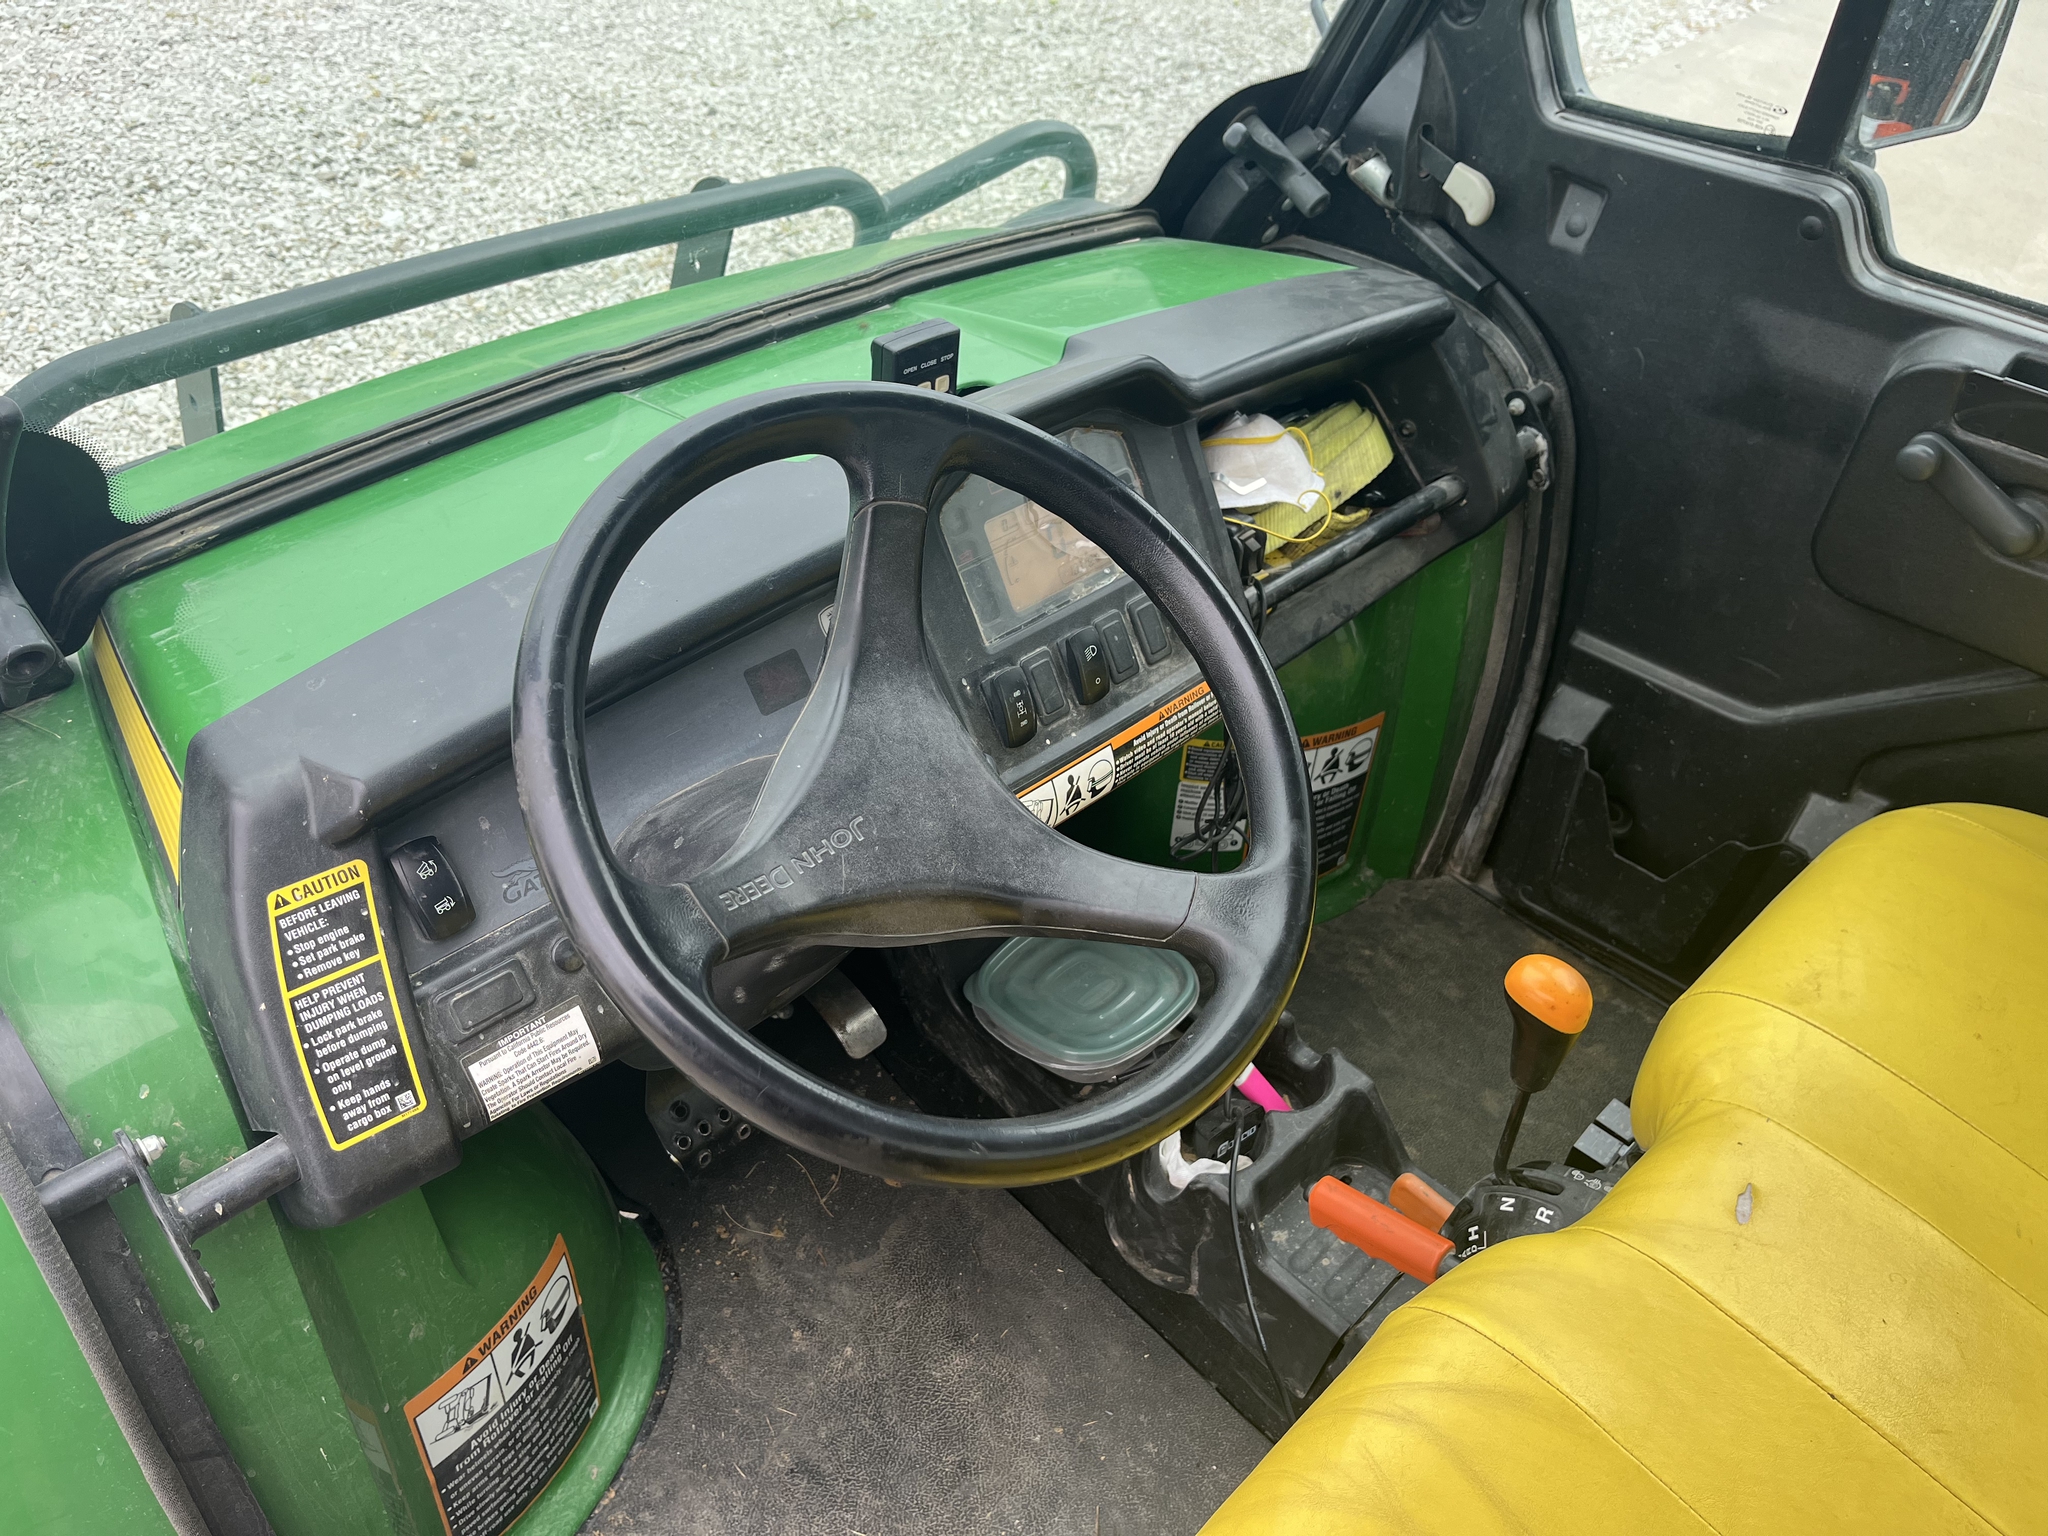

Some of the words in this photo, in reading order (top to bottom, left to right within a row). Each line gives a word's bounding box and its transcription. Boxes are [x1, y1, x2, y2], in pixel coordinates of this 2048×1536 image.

[903, 366, 917, 375] OPEN
[920, 358, 937, 369] CLOSE
[940, 353, 954, 363] STOP
[1164, 687, 1205, 716] WARNING
[1313, 727, 1357, 747] WARNING
[791, 816, 865, 875] JOHN
[291, 864, 361, 902] CAUTION
[718, 865, 795, 912] DEERE
[279, 905, 319, 930] BEFORE
[319, 889, 361, 912] LEAVING
[284, 918, 330, 942] VEHICLE:
[292, 940, 316, 955] Stop
[318, 925, 350, 945] engine
[299, 953, 317, 967] Set
[318, 944, 339, 961] park
[340, 932, 366, 950] brake
[303, 957, 343, 978] Remove
[343, 948, 361, 962] key
[294, 992, 320, 1011] HELP
[321, 973, 366, 999] PREVENT
[299, 999, 336, 1022] INJURY
[336, 985, 368, 1006] WHEN
[304, 1007, 351, 1034] DUMPING
[352, 991, 385, 1013] LOADS
[310, 1030, 335, 1047] Lock
[335, 1020, 357, 1038] park
[358, 1009, 384, 1023] brake
[315, 1039, 347, 1058] before
[348, 1020, 388, 1044] dumping
[497, 1014, 547, 1048] IMPORTANT
[322, 1050, 360, 1073] Operate
[360, 1037, 387, 1055] dump
[327, 1072, 340, 1084] on
[341, 1060, 365, 1078] level
[365, 1044, 398, 1068] ground
[332, 1079, 353, 1095] only
[337, 1094, 362, 1110] Keep
[362, 1079, 392, 1098] hands
[342, 1105, 367, 1121] away
[367, 1093, 391, 1109] from
[347, 1115, 373, 1132] cargo
[374, 1104, 393, 1118] box
[1500, 1197, 1515, 1211] N
[1535, 1206, 1554, 1224] R
[1468, 1225, 1479, 1241] H
[478, 1285, 538, 1357] WARNING
[470, 1418, 499, 1451] Avoid
[500, 1388, 527, 1420] Injury
[528, 1374, 538, 1389] or
[539, 1343, 562, 1376] Death
[455, 1447, 481, 1472] from
[482, 1403, 523, 1448] Rollover
[525, 1390, 535, 1404] or
[535, 1354, 562, 1390] Falling
[447, 1473, 466, 1490] Wear
[450, 1491, 458, 1499] or
[459, 1469, 483, 1492] uneven
[453, 1491, 471, 1508] Keep
[471, 1476, 489, 1493] arms
[489, 1463, 501, 1477] and
[455, 1498, 476, 1517] While
[458, 1509, 475, 1525] Drive
[461, 1515, 480, 1535] paved
